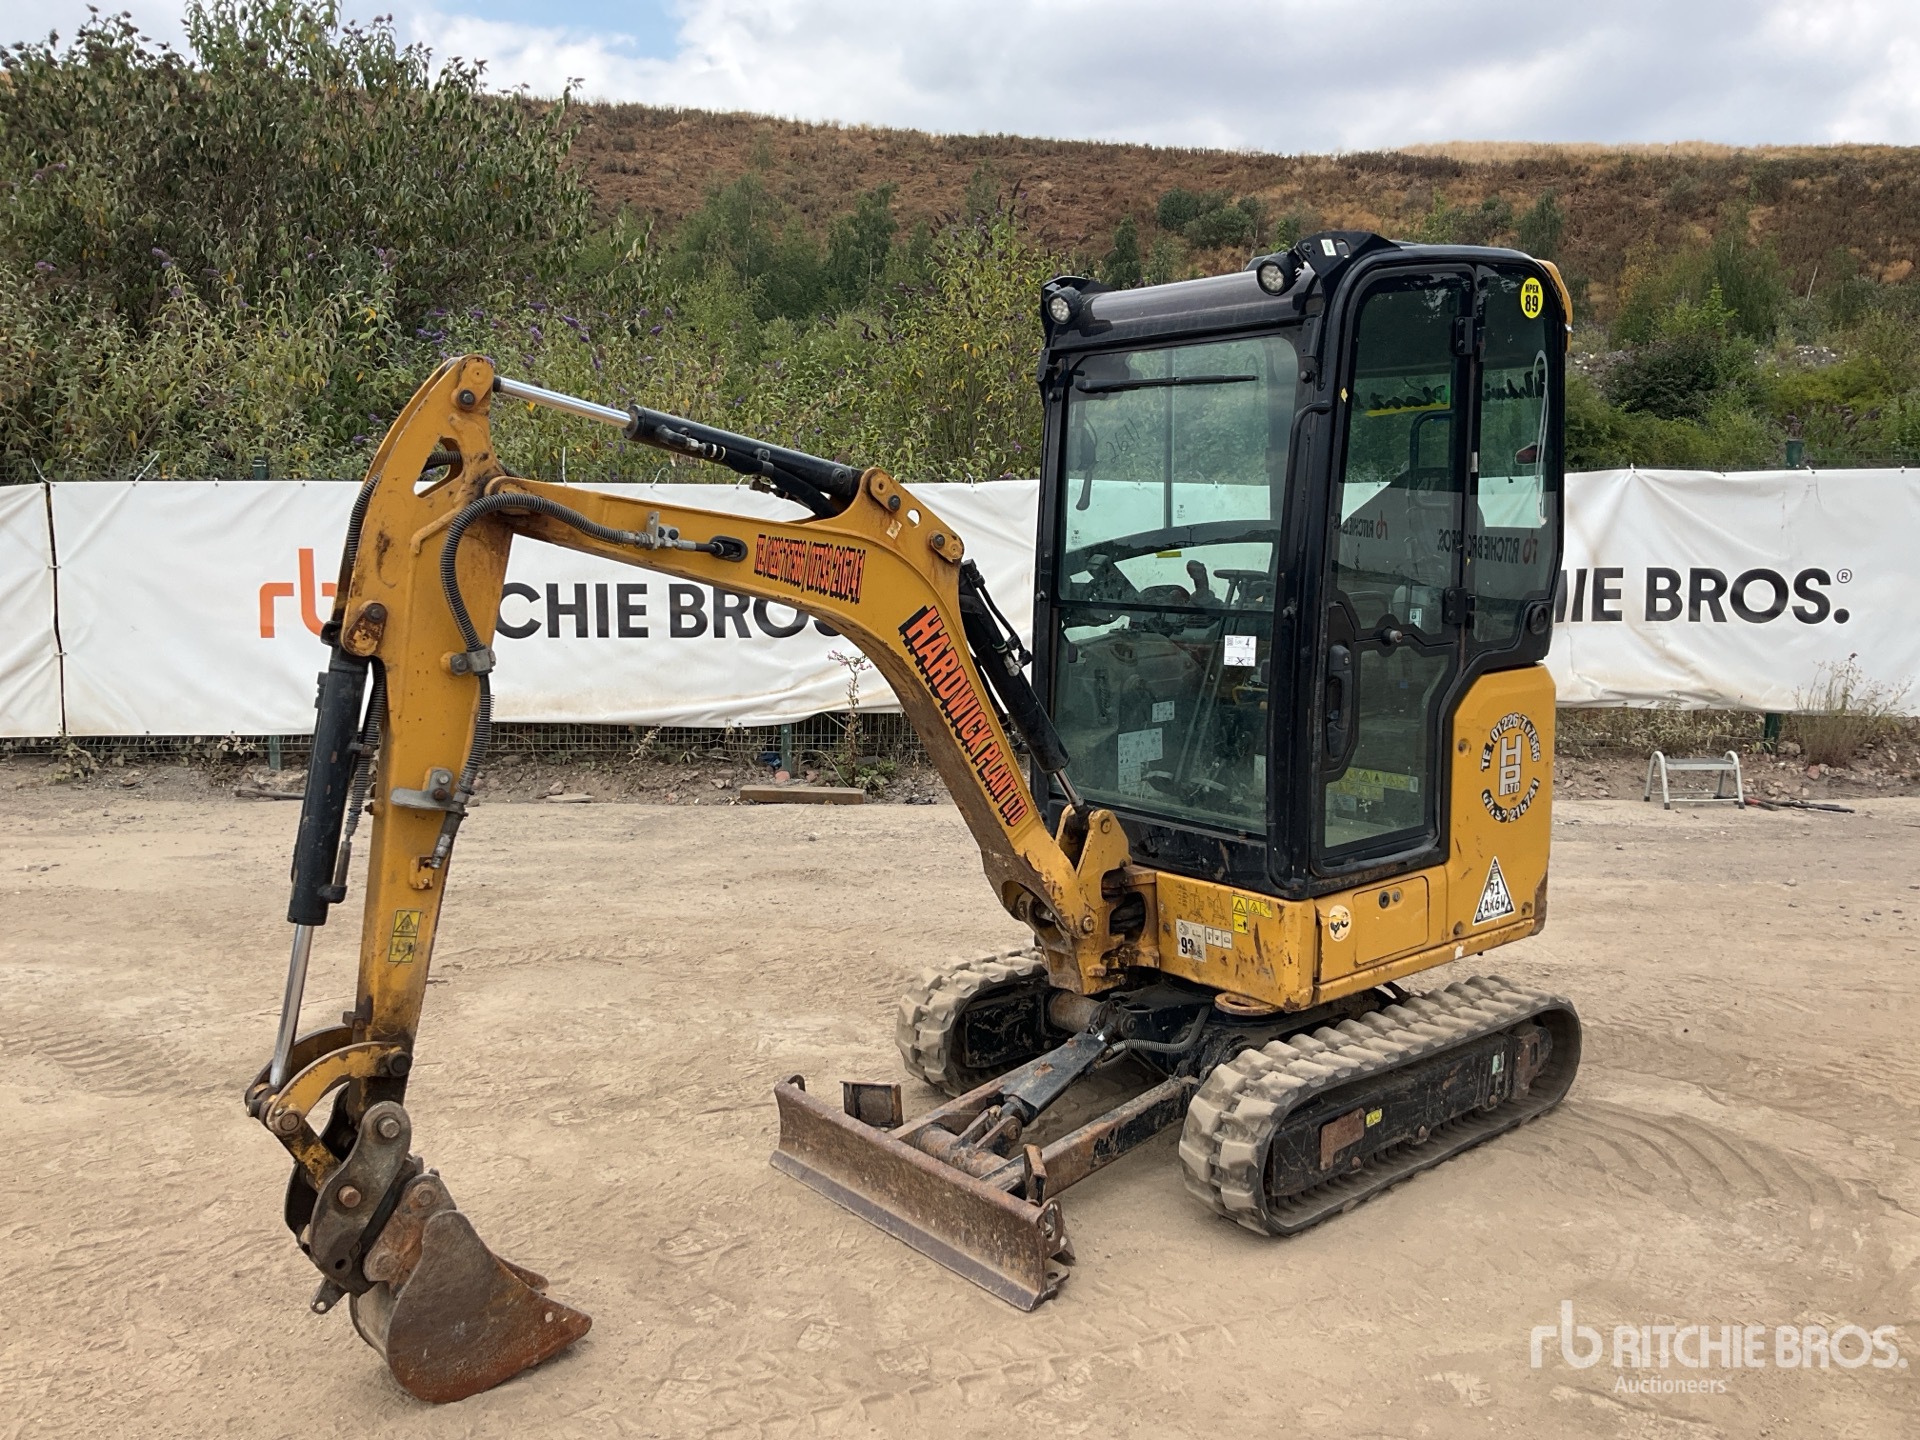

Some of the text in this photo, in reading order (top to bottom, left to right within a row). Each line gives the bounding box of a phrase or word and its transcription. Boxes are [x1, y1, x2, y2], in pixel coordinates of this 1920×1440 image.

[1525, 295, 1538, 312] 89
[495, 582, 649, 640] CHIE
[898, 605, 1029, 827] HARDWICK PLANT LTD
[1490, 712, 1520, 744] 01226
[1505, 782, 1520, 795] LTD
